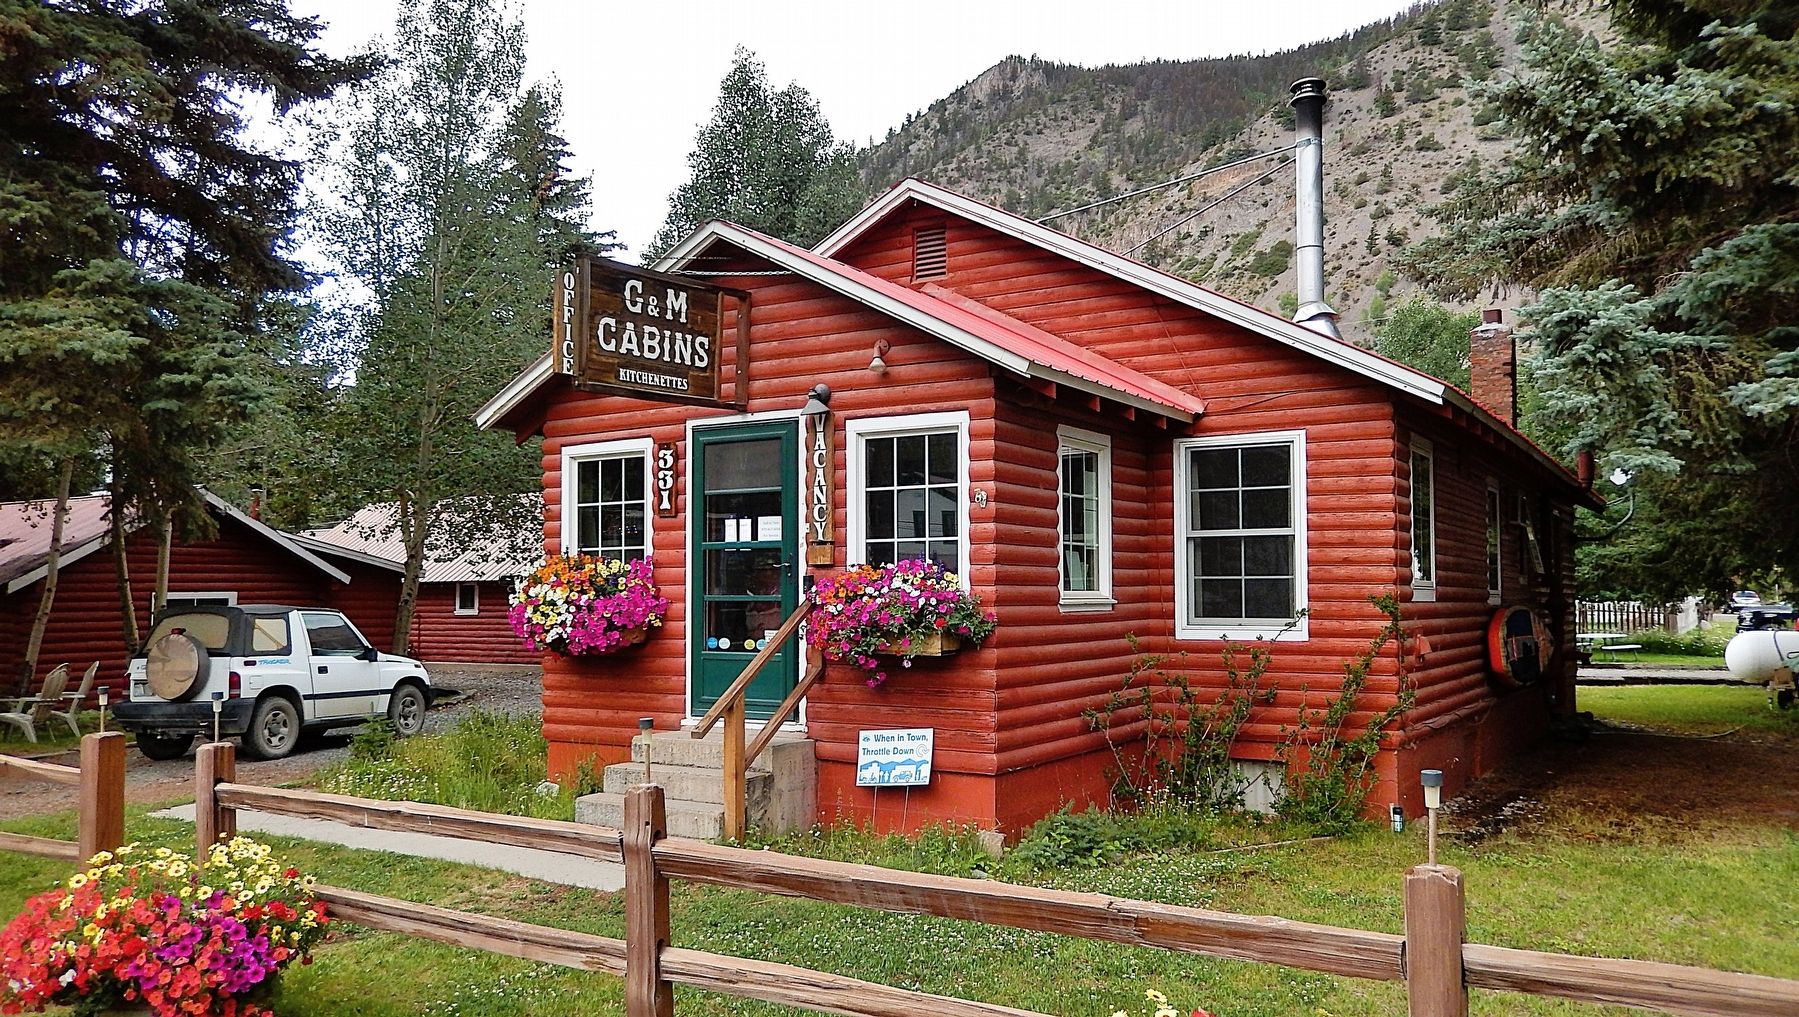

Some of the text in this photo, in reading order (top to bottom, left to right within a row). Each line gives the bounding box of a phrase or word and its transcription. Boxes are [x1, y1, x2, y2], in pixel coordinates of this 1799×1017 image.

[563, 272, 575, 375] OFFICE
[665, 288, 687, 323] M
[597, 316, 709, 367] CABINS
[619, 368, 688, 390] KITCHENETTES
[658, 449, 673, 510] 331
[813, 413, 827, 541] VACANCY
[862, 746, 914, 756] Throttle Down
[873, 733, 895, 743] When
